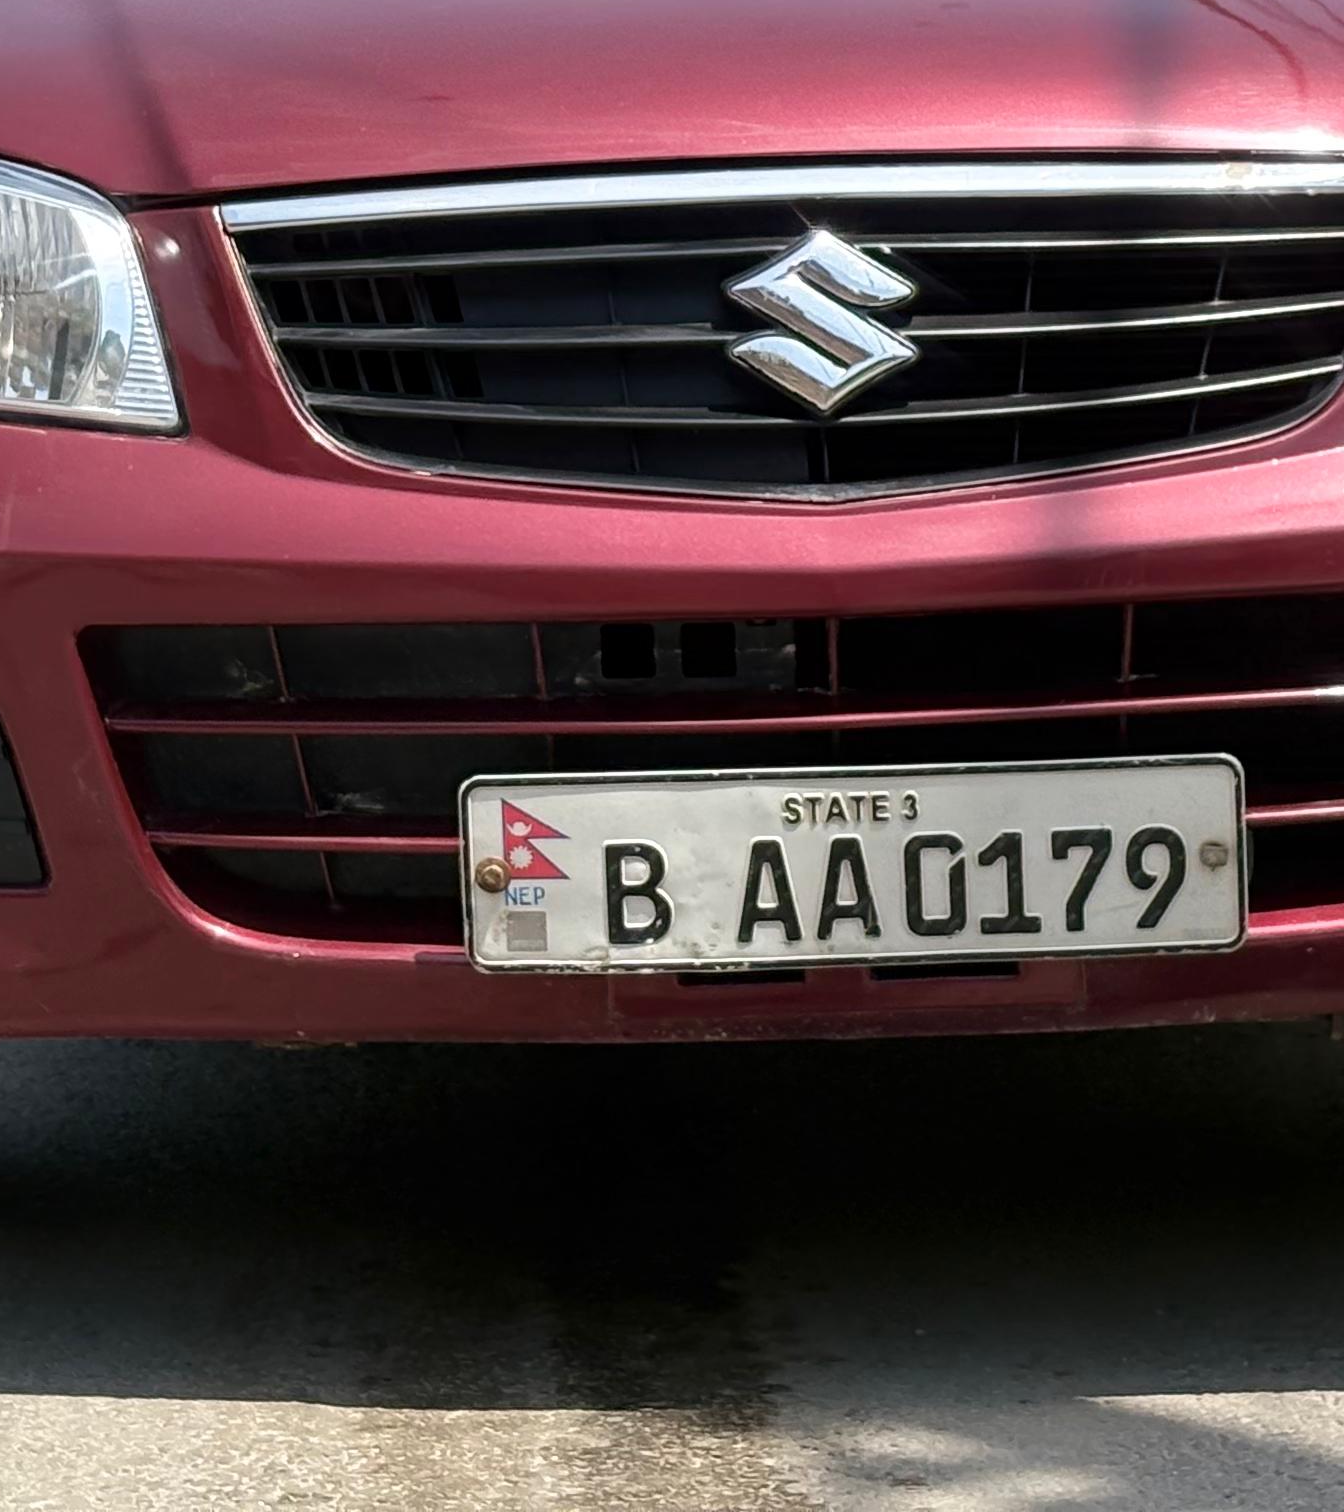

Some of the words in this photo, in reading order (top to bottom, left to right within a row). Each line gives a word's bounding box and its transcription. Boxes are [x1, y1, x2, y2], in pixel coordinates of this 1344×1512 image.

[783, 791, 891, 826] STATE
[902, 789, 920, 821] 3
[504, 885, 546, 907] NEP
[602, 838, 676, 946] B
